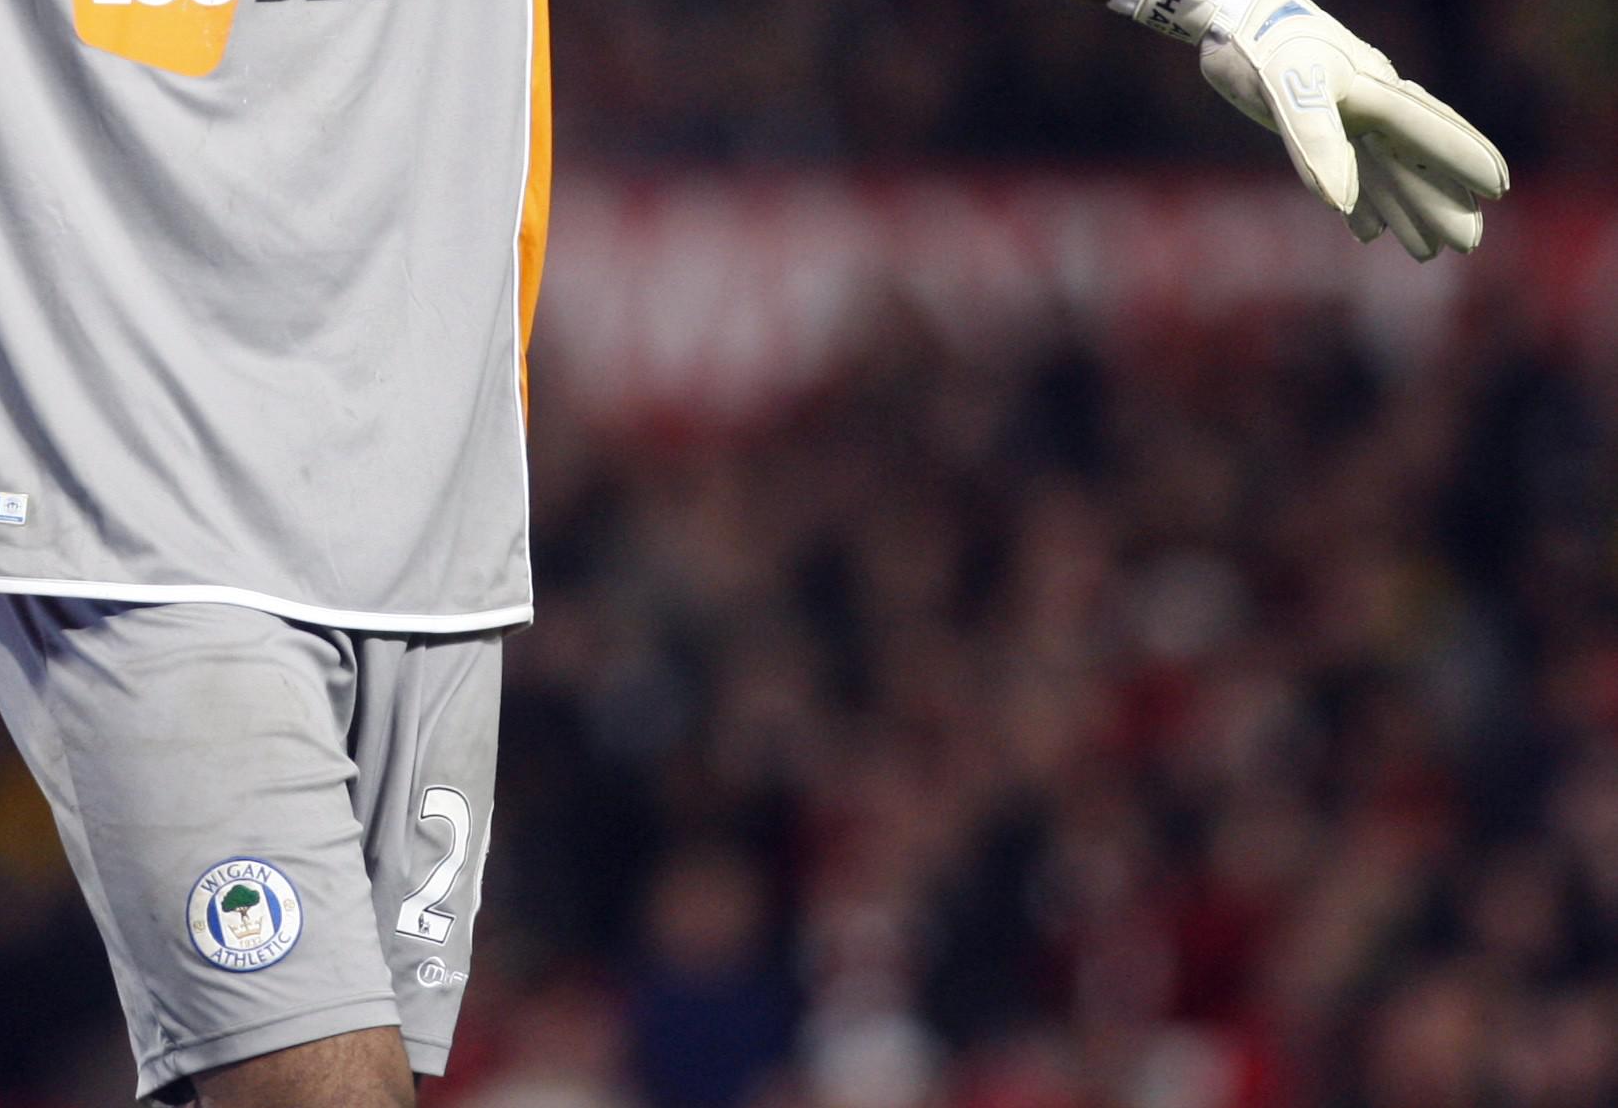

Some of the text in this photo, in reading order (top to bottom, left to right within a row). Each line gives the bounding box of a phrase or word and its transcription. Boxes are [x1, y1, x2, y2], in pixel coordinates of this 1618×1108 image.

[200, 864, 272, 894] WIGAN
[395, 785, 490, 946] 2
[210, 931, 292, 967] ATHLETIC
